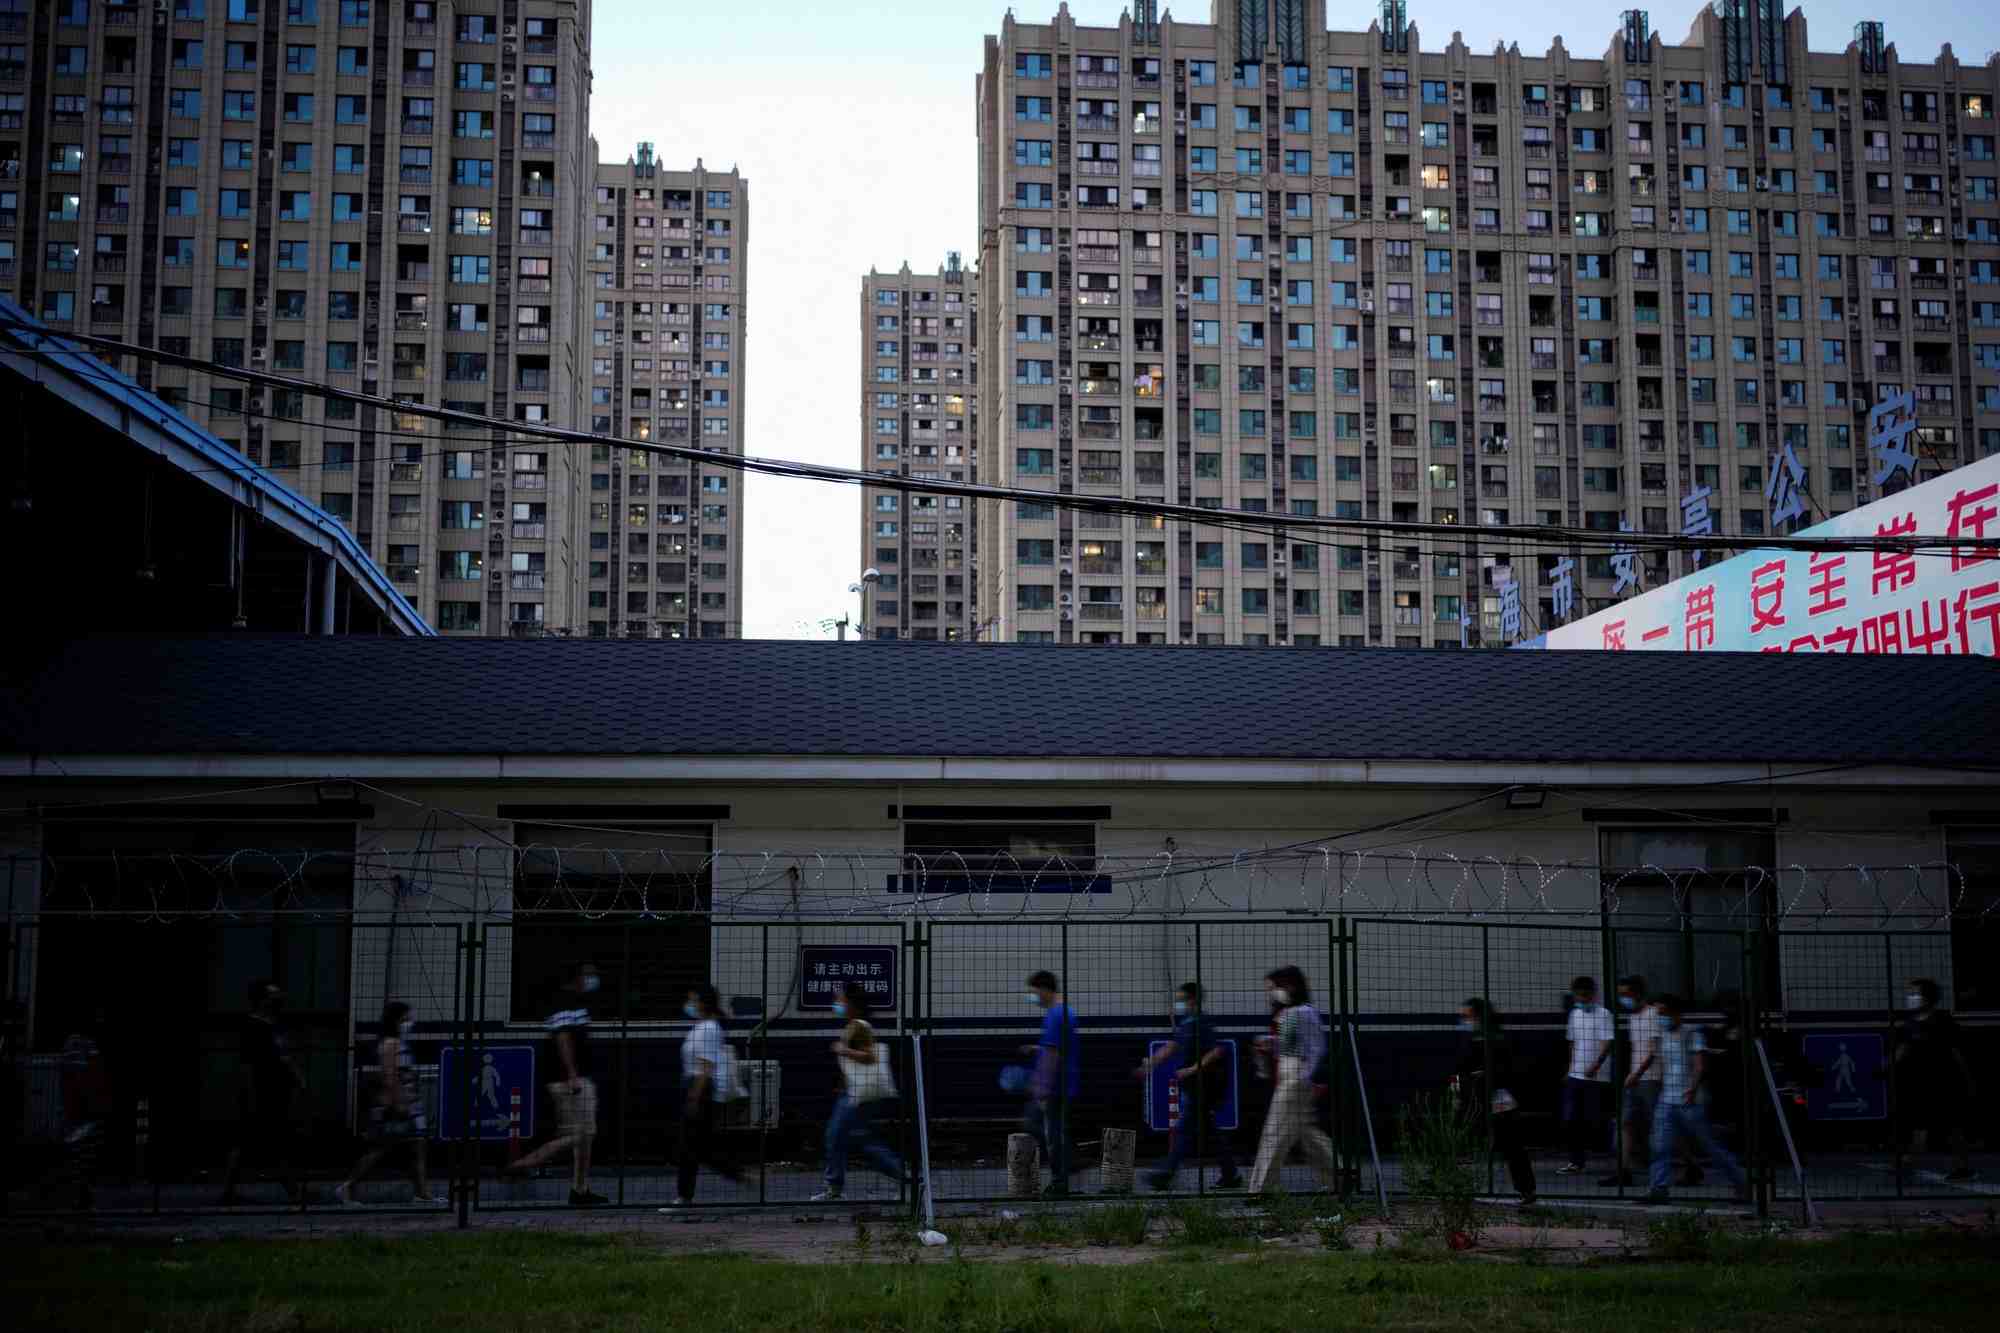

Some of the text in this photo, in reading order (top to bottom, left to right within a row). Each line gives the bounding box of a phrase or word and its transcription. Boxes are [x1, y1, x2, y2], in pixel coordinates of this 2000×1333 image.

[814, 962, 881, 976] 请主动出示
